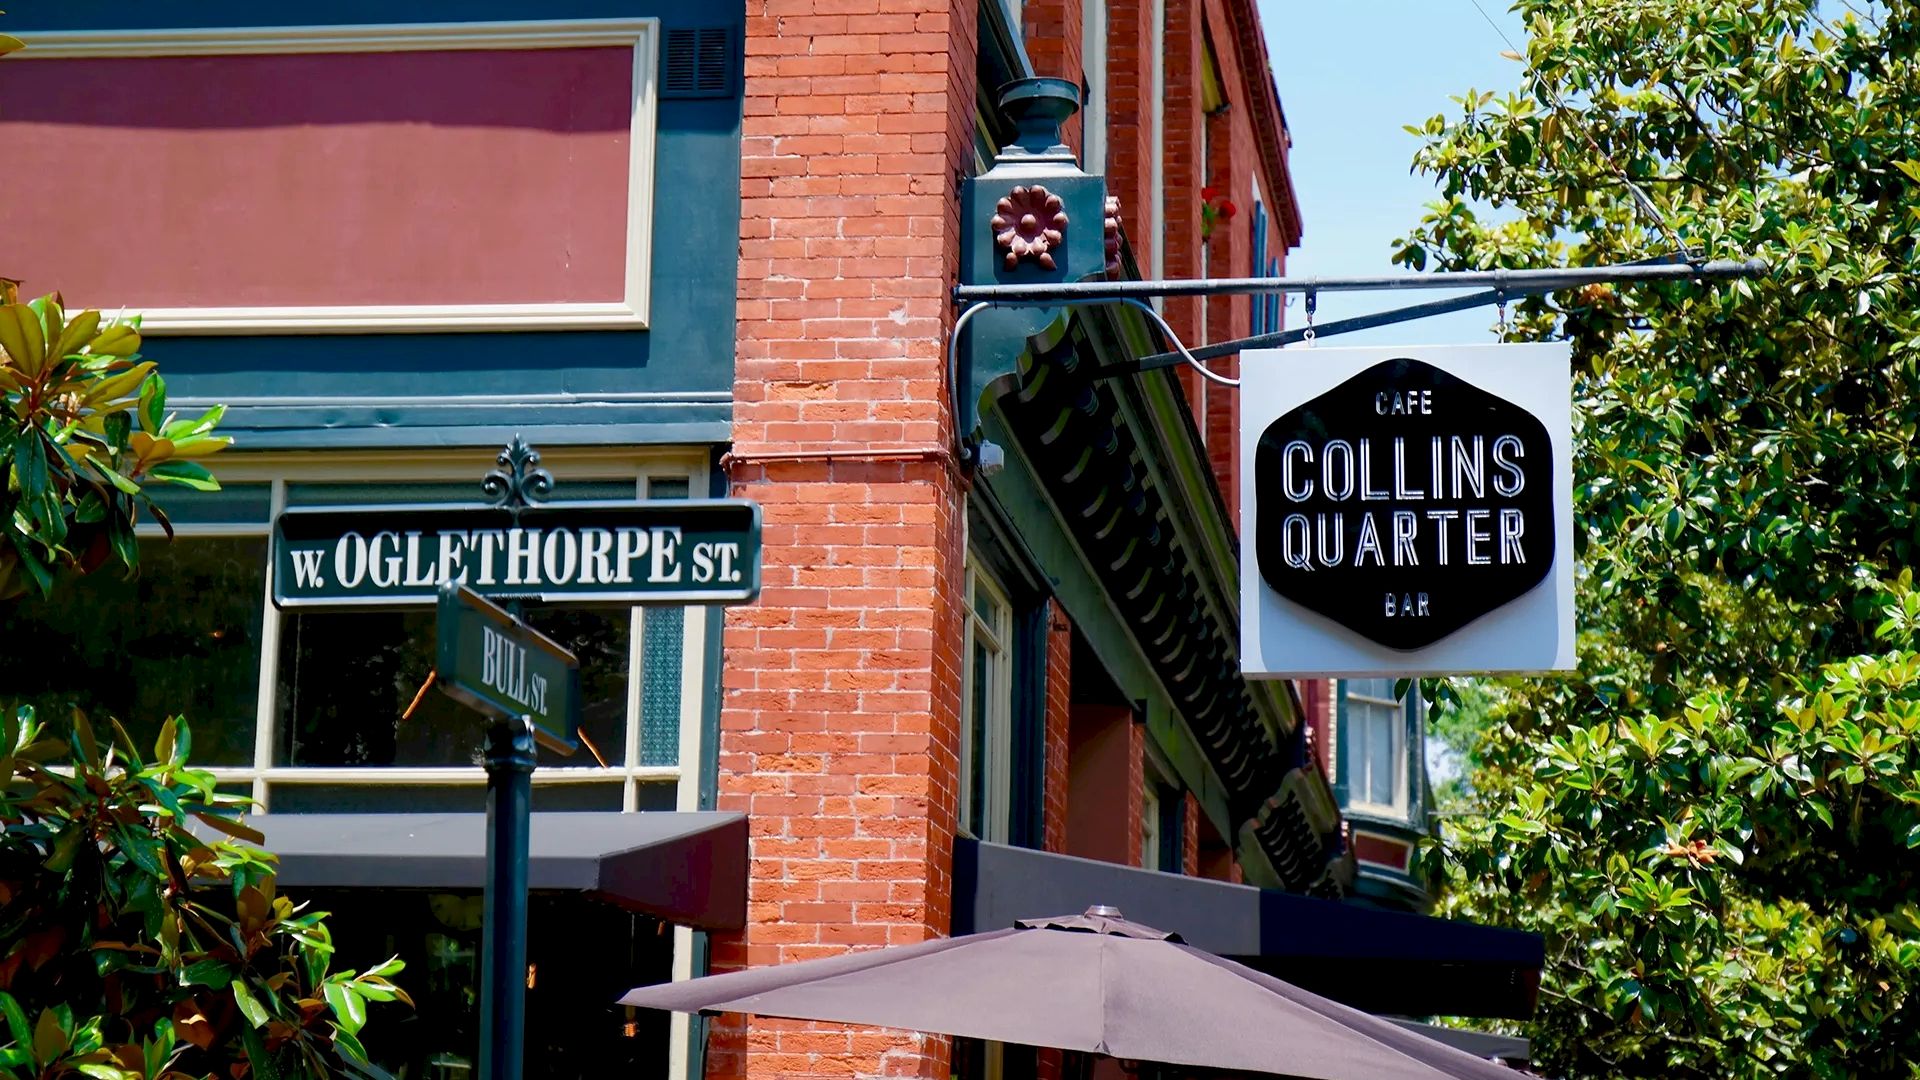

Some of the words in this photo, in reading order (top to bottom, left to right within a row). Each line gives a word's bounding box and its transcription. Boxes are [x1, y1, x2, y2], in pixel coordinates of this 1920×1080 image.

[1375, 390, 1432, 415] CAFE
[1282, 435, 1525, 502] COLLINS
[290, 549, 325, 588] W.
[334, 526, 682, 588] OGLETHORPE
[692, 541, 742, 583] ST.
[1282, 509, 1526, 571] QUARTER
[1385, 592, 1430, 617] BAR
[481, 625, 531, 707] BULL
[531, 672, 548, 717] ST.
